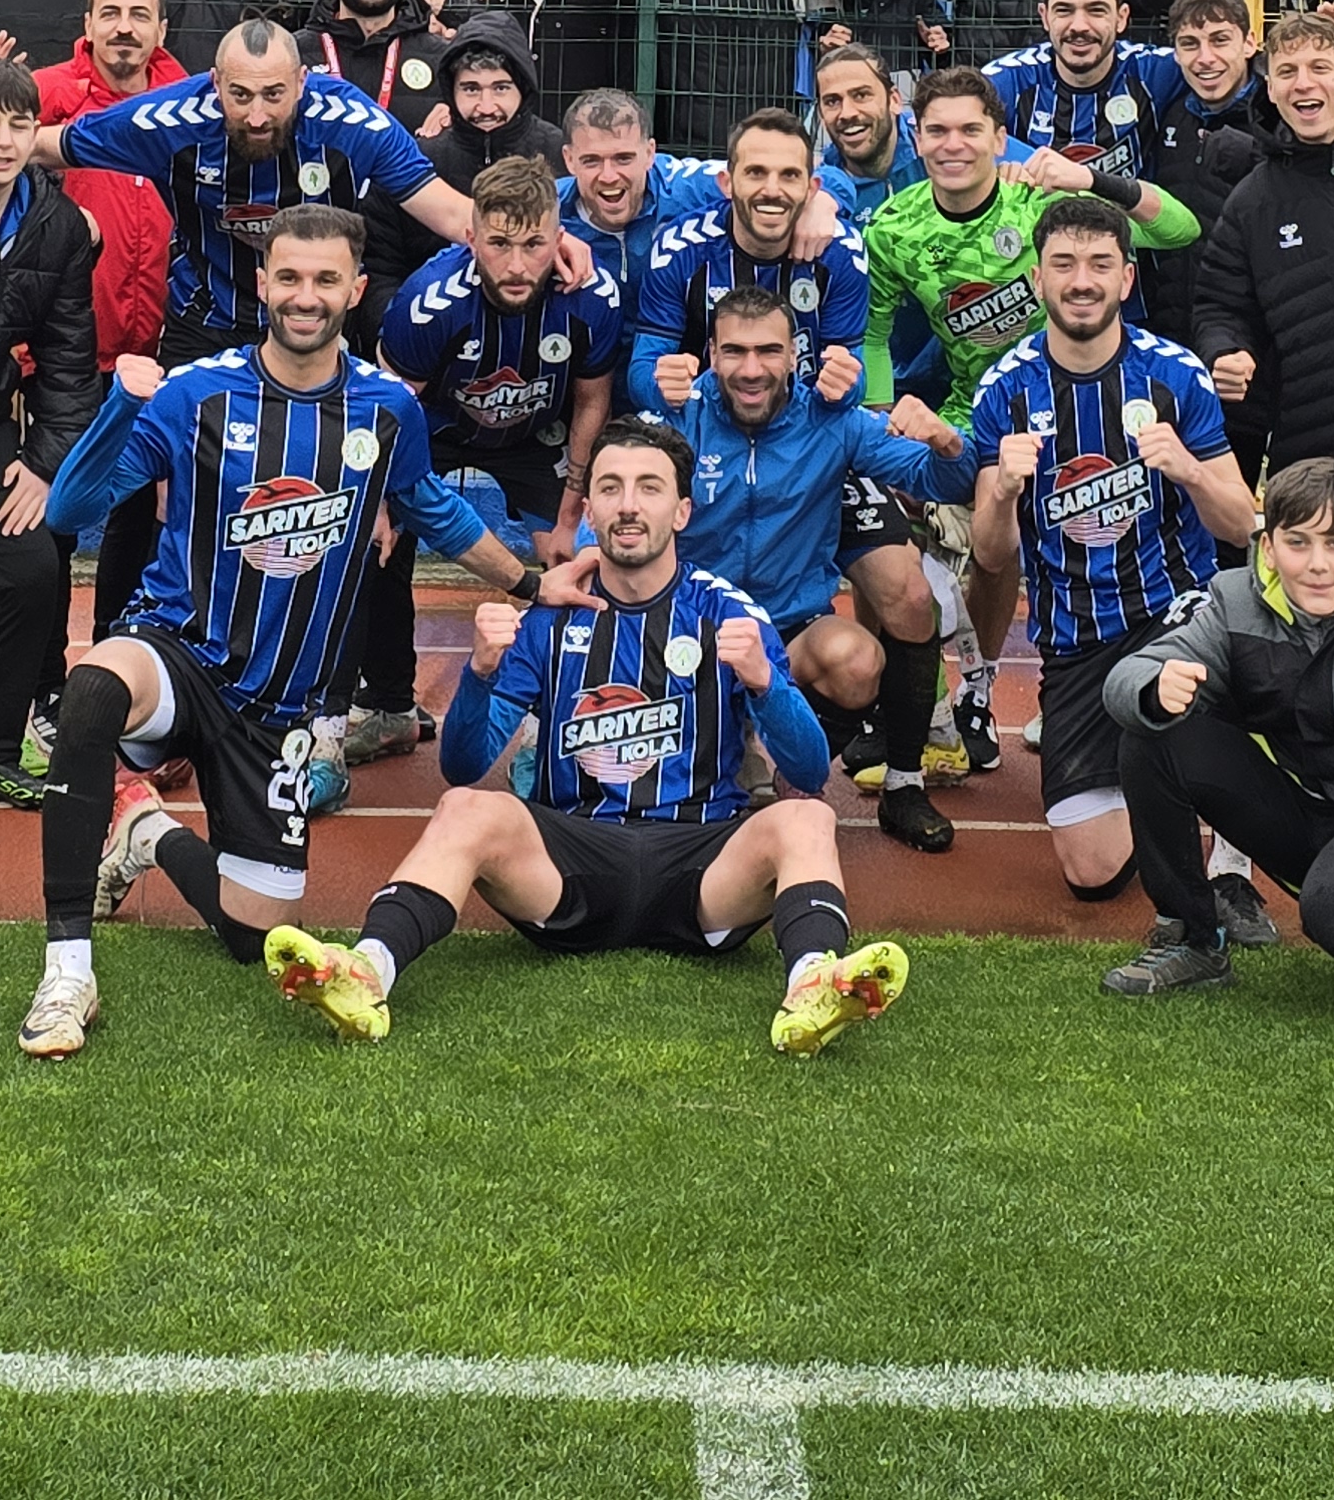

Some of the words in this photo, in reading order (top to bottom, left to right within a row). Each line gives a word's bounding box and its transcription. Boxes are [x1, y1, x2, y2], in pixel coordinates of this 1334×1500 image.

[947, 281, 1029, 333] SARIYER
[995, 302, 1038, 332] KOLA
[500, 399, 547, 420] KOLA
[1047, 464, 1145, 520] SARIYER
[230, 495, 349, 543] SARIYER
[1101, 494, 1150, 527] KOLA
[288, 527, 341, 557] KOLA
[564, 702, 679, 749] SARIYER
[621, 735, 677, 763] KOLA
